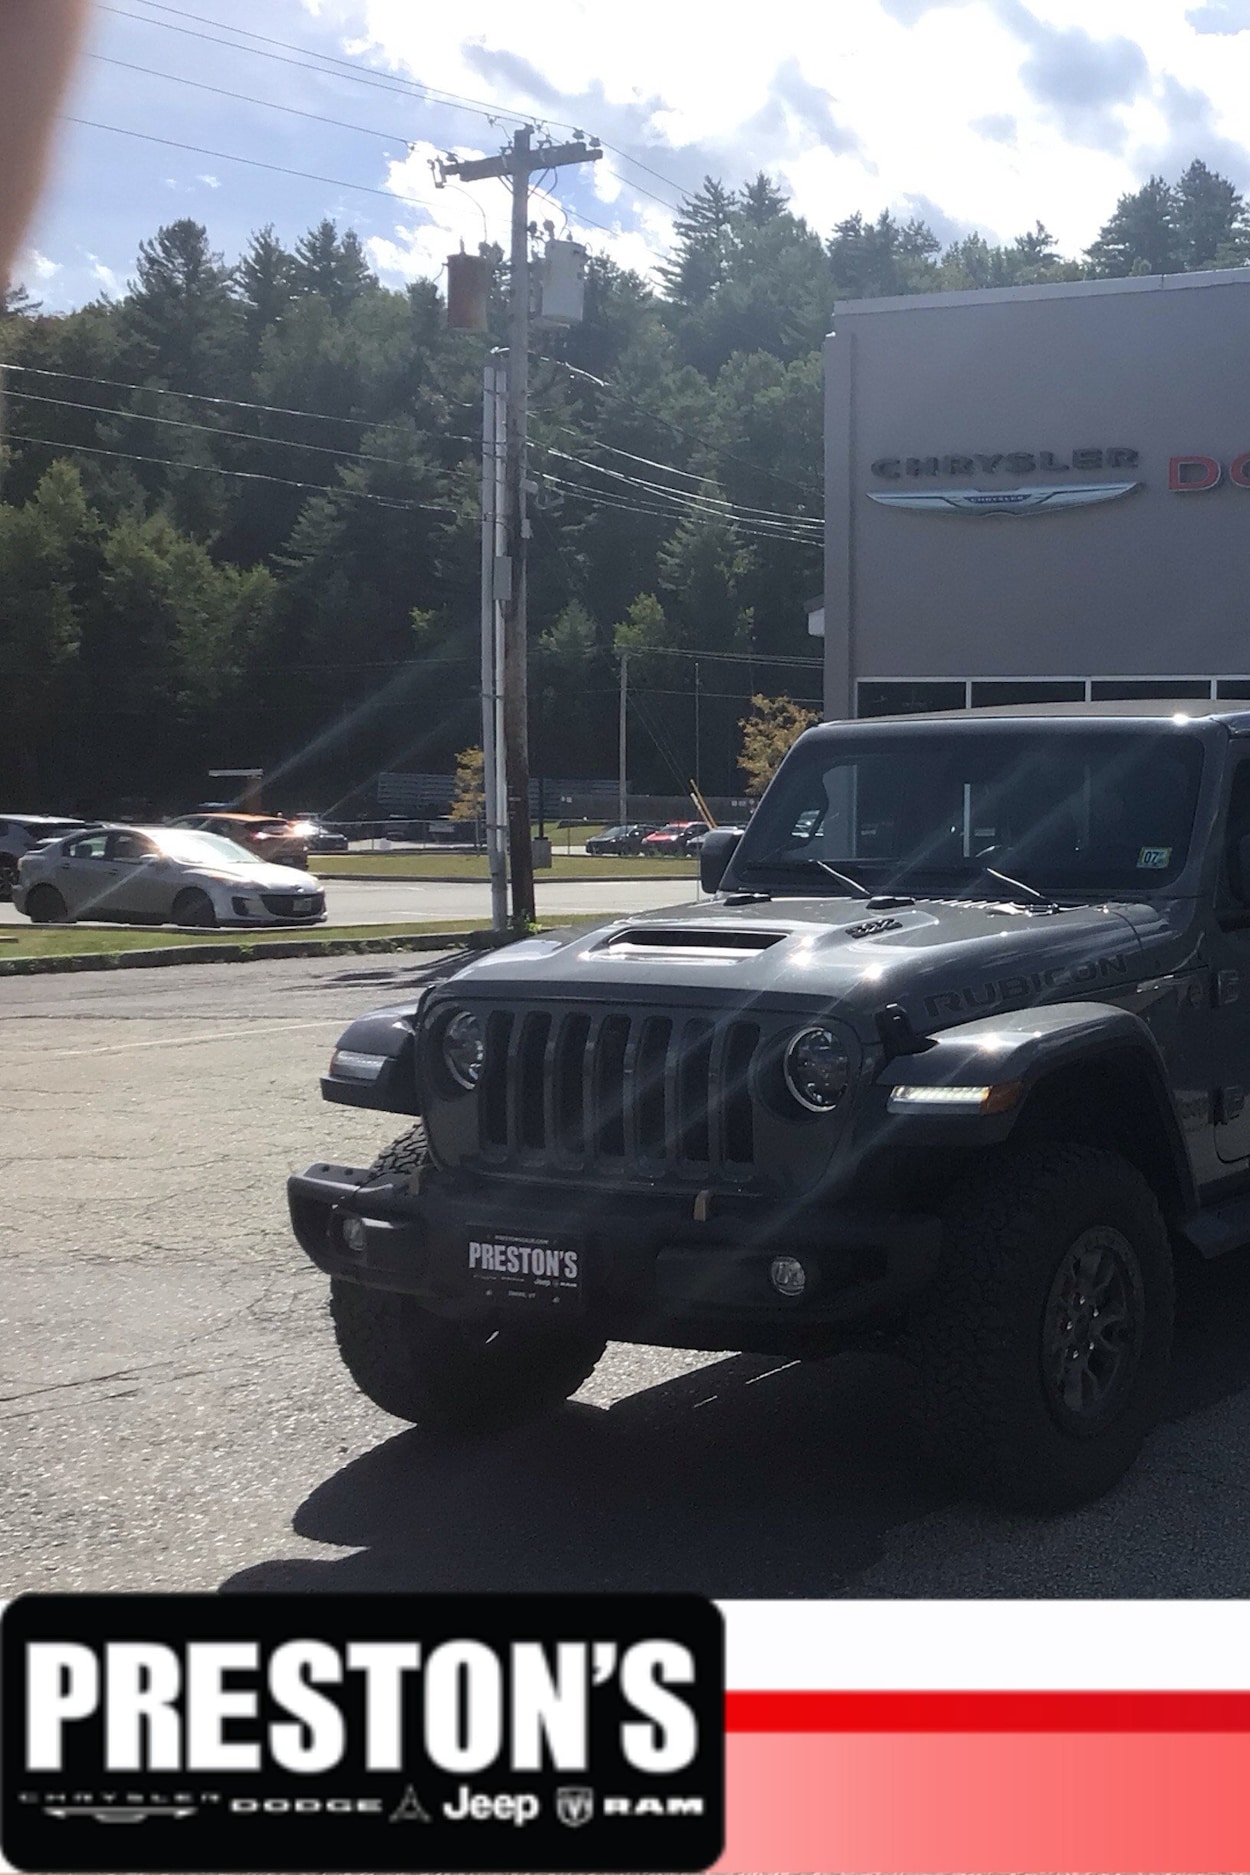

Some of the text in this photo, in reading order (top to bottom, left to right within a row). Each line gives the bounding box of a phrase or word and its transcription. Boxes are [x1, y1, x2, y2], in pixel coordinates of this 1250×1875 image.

[870, 447, 1139, 480] CHRYSLER
[922, 953, 1130, 1018] RUBICON
[468, 1241, 578, 1279] PRESTON'S
